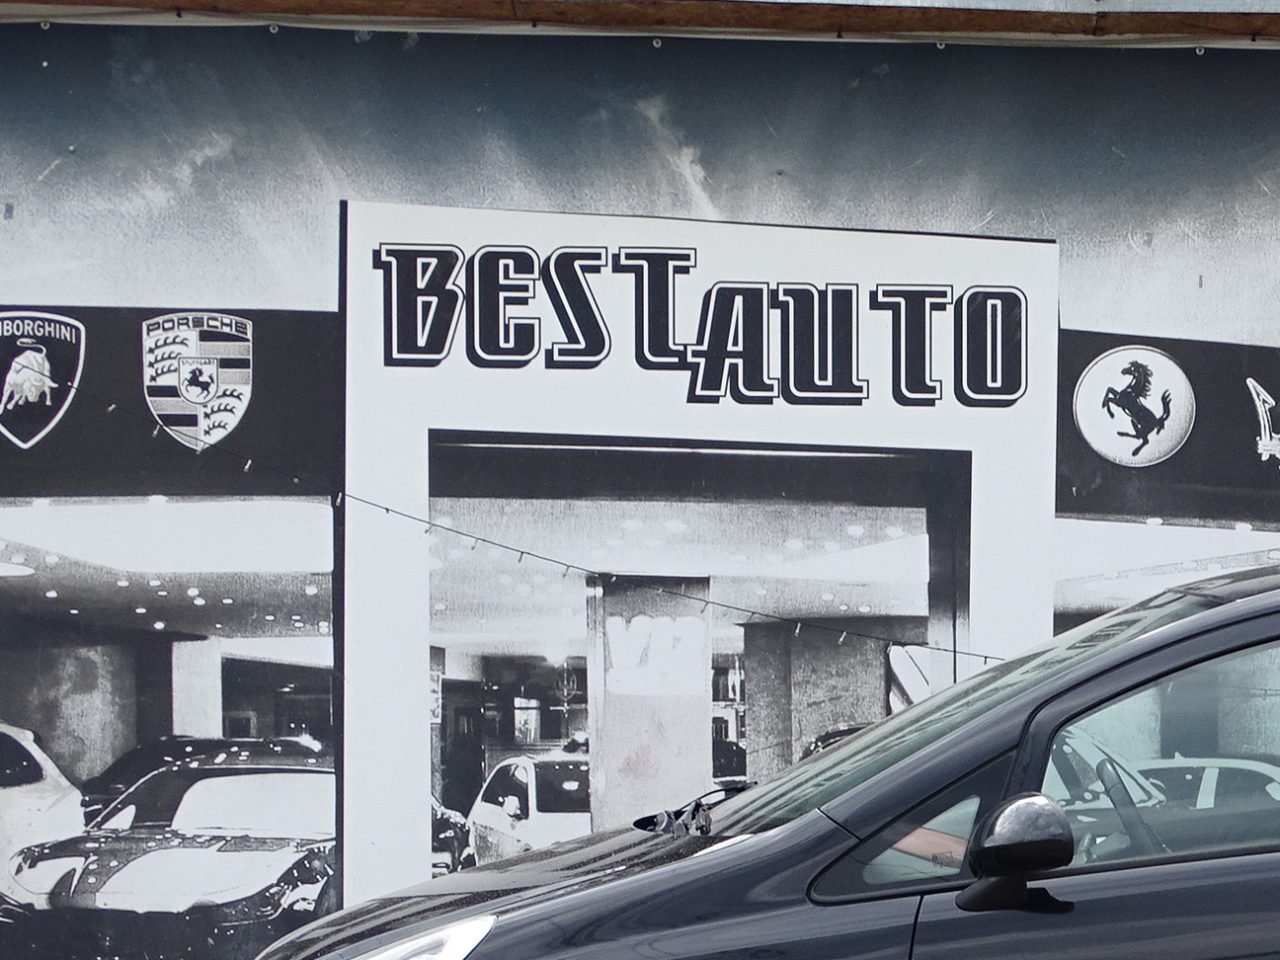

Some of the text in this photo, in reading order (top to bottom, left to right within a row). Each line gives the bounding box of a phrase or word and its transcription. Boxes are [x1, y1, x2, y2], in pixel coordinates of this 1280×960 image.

[0, 319, 77, 344] BORGHINI
[146, 315, 249, 337] PORSCHE
[372, 243, 1029, 408] BESTAUTO
